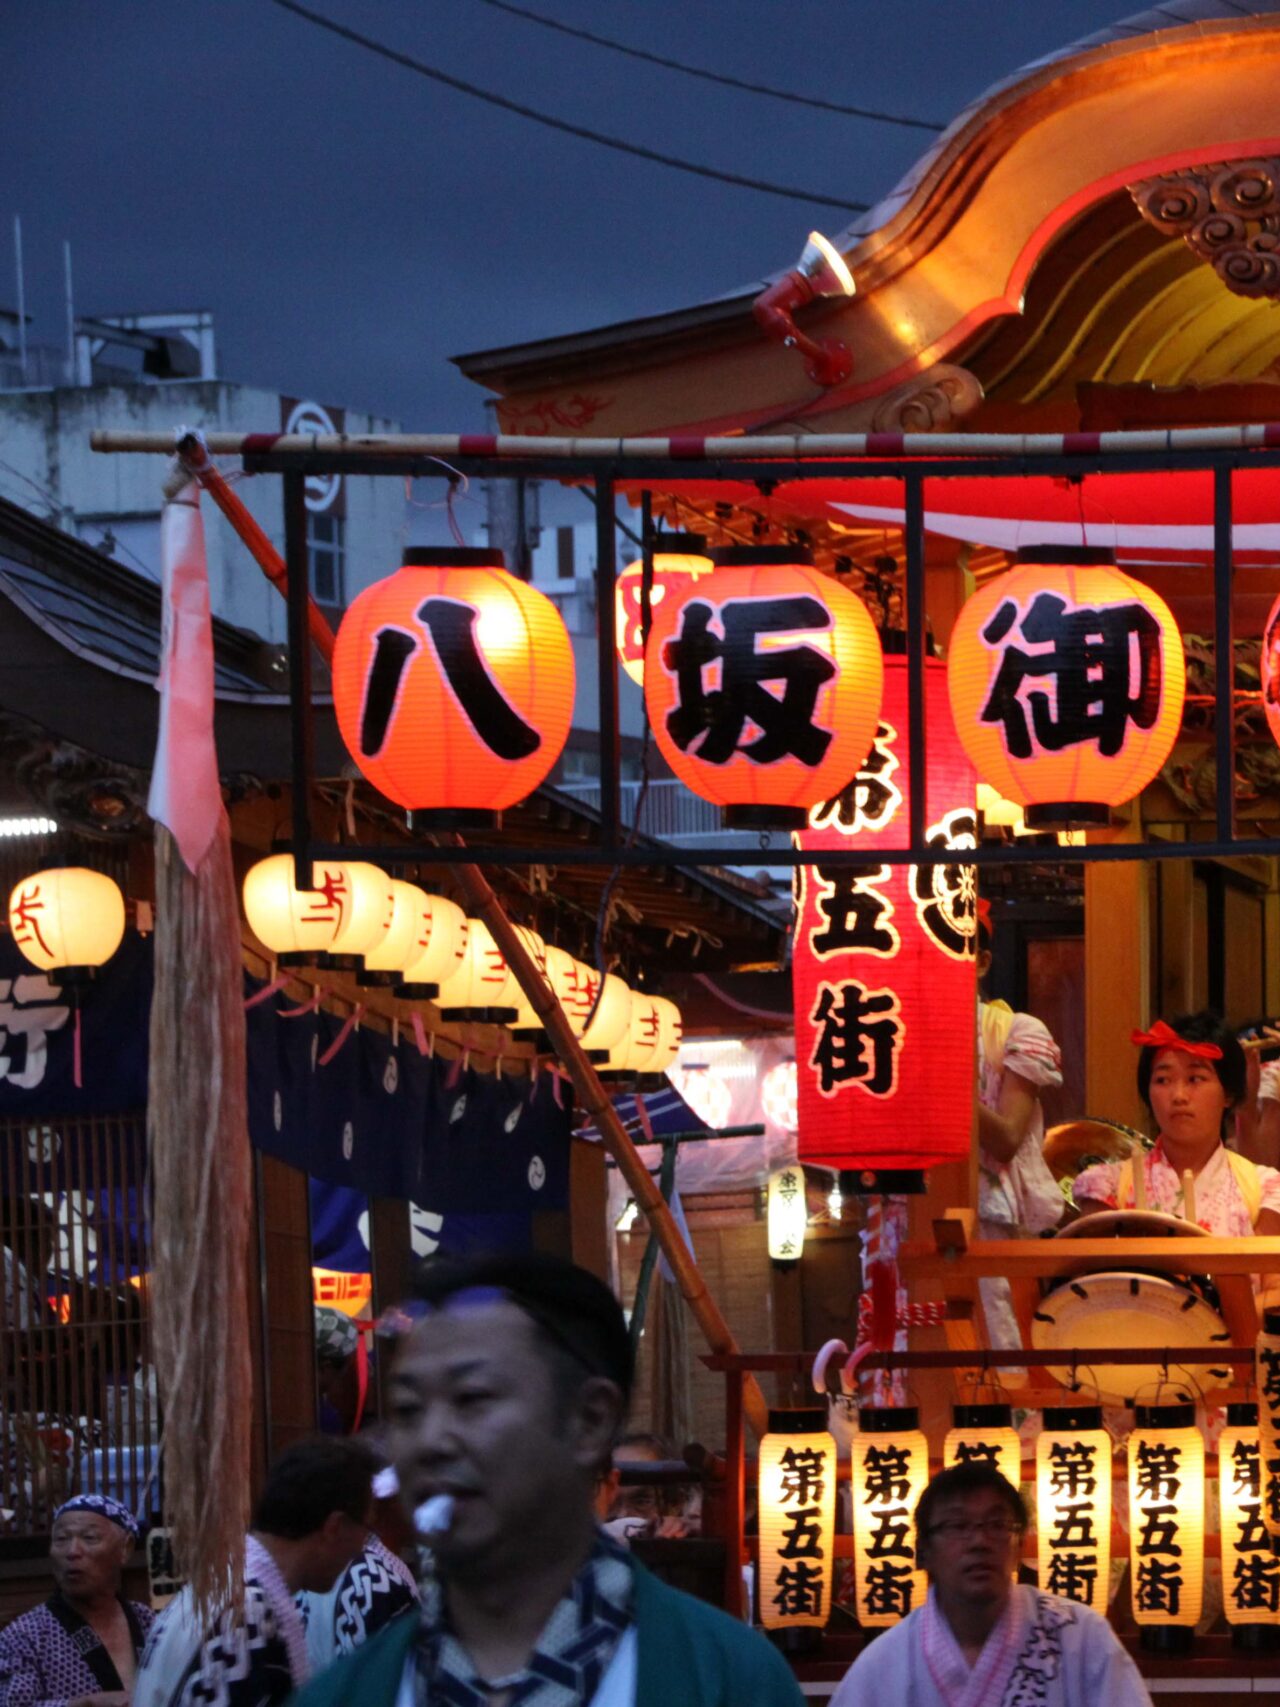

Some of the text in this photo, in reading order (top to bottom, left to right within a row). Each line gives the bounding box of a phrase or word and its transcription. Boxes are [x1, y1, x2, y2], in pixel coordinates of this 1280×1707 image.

[361, 597, 540, 760] 八
[663, 596, 838, 766] 坂
[979, 592, 1163, 760] 御
[774, 1446, 825, 1617] 第五街
[862, 1444, 915, 1617] 第五街
[1048, 1441, 1098, 1604] 第五街
[1135, 1440, 1184, 1616] 第五街
